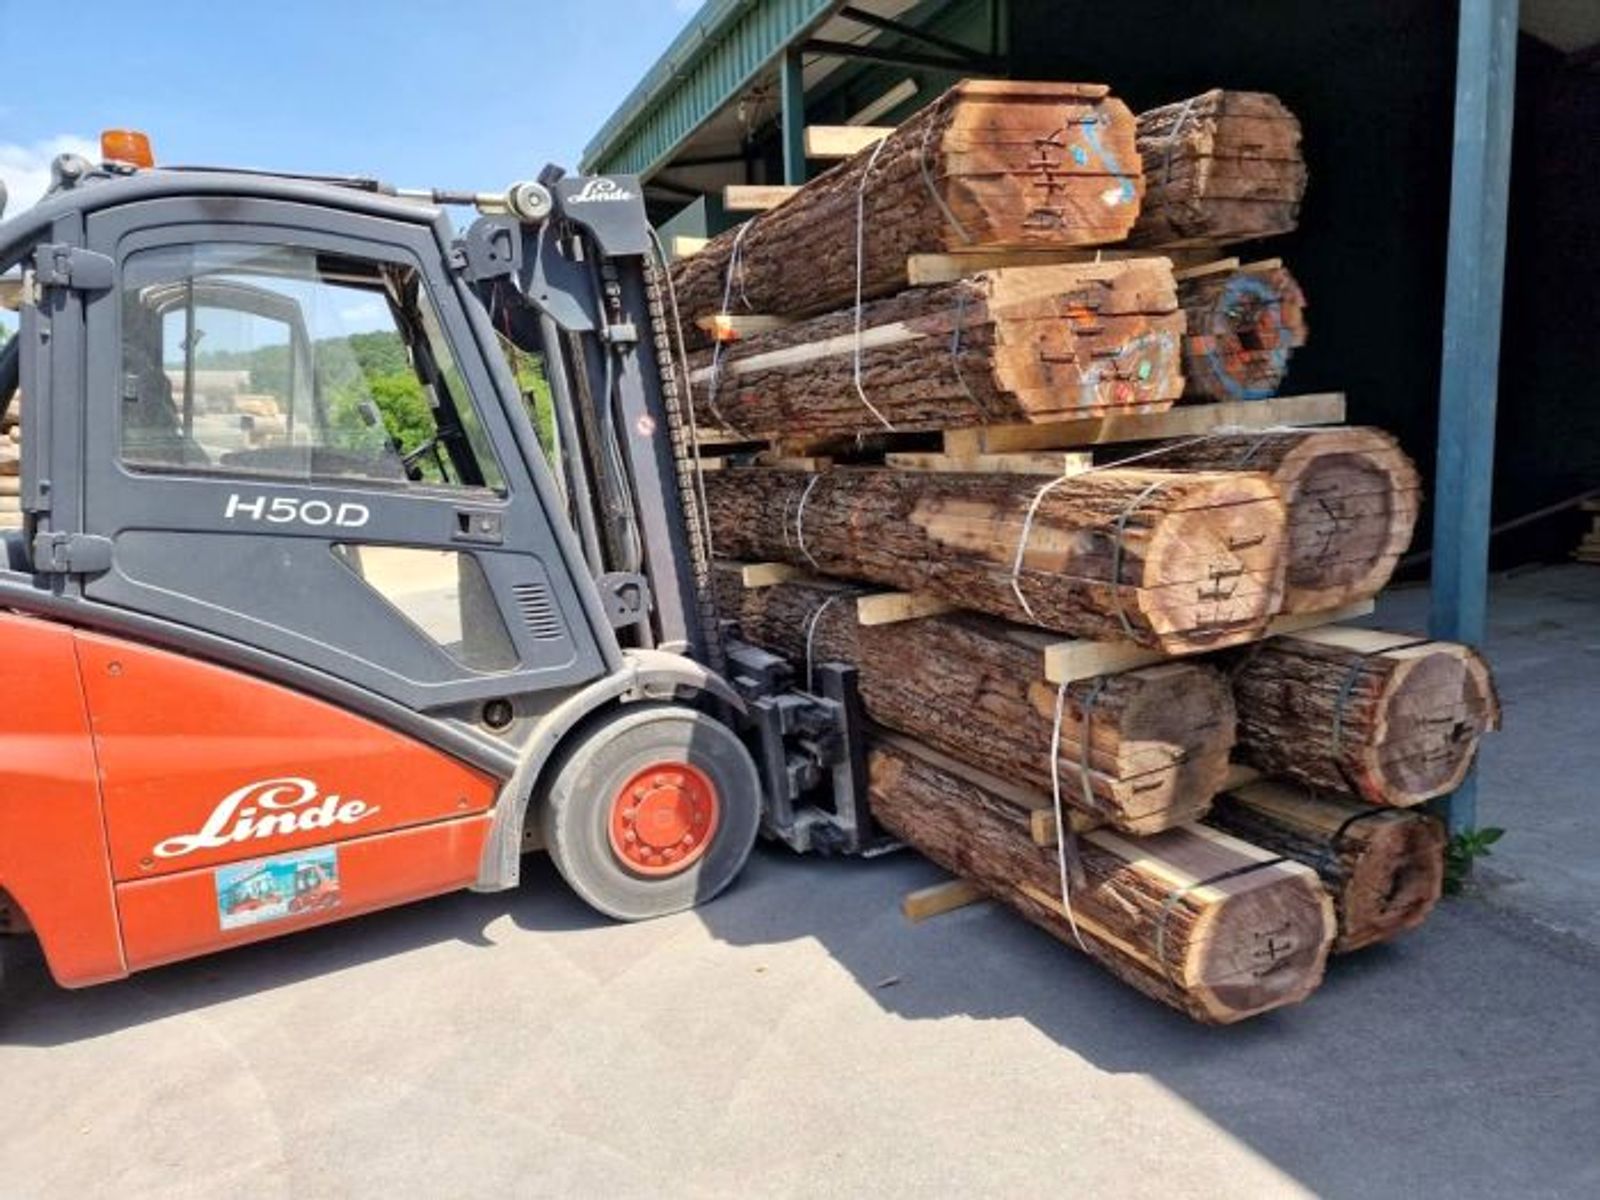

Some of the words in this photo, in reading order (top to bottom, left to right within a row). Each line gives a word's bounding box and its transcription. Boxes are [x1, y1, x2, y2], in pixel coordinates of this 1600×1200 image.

[567, 178, 636, 204] Linde
[224, 494, 369, 527] H50D
[153, 777, 380, 857] Linde
